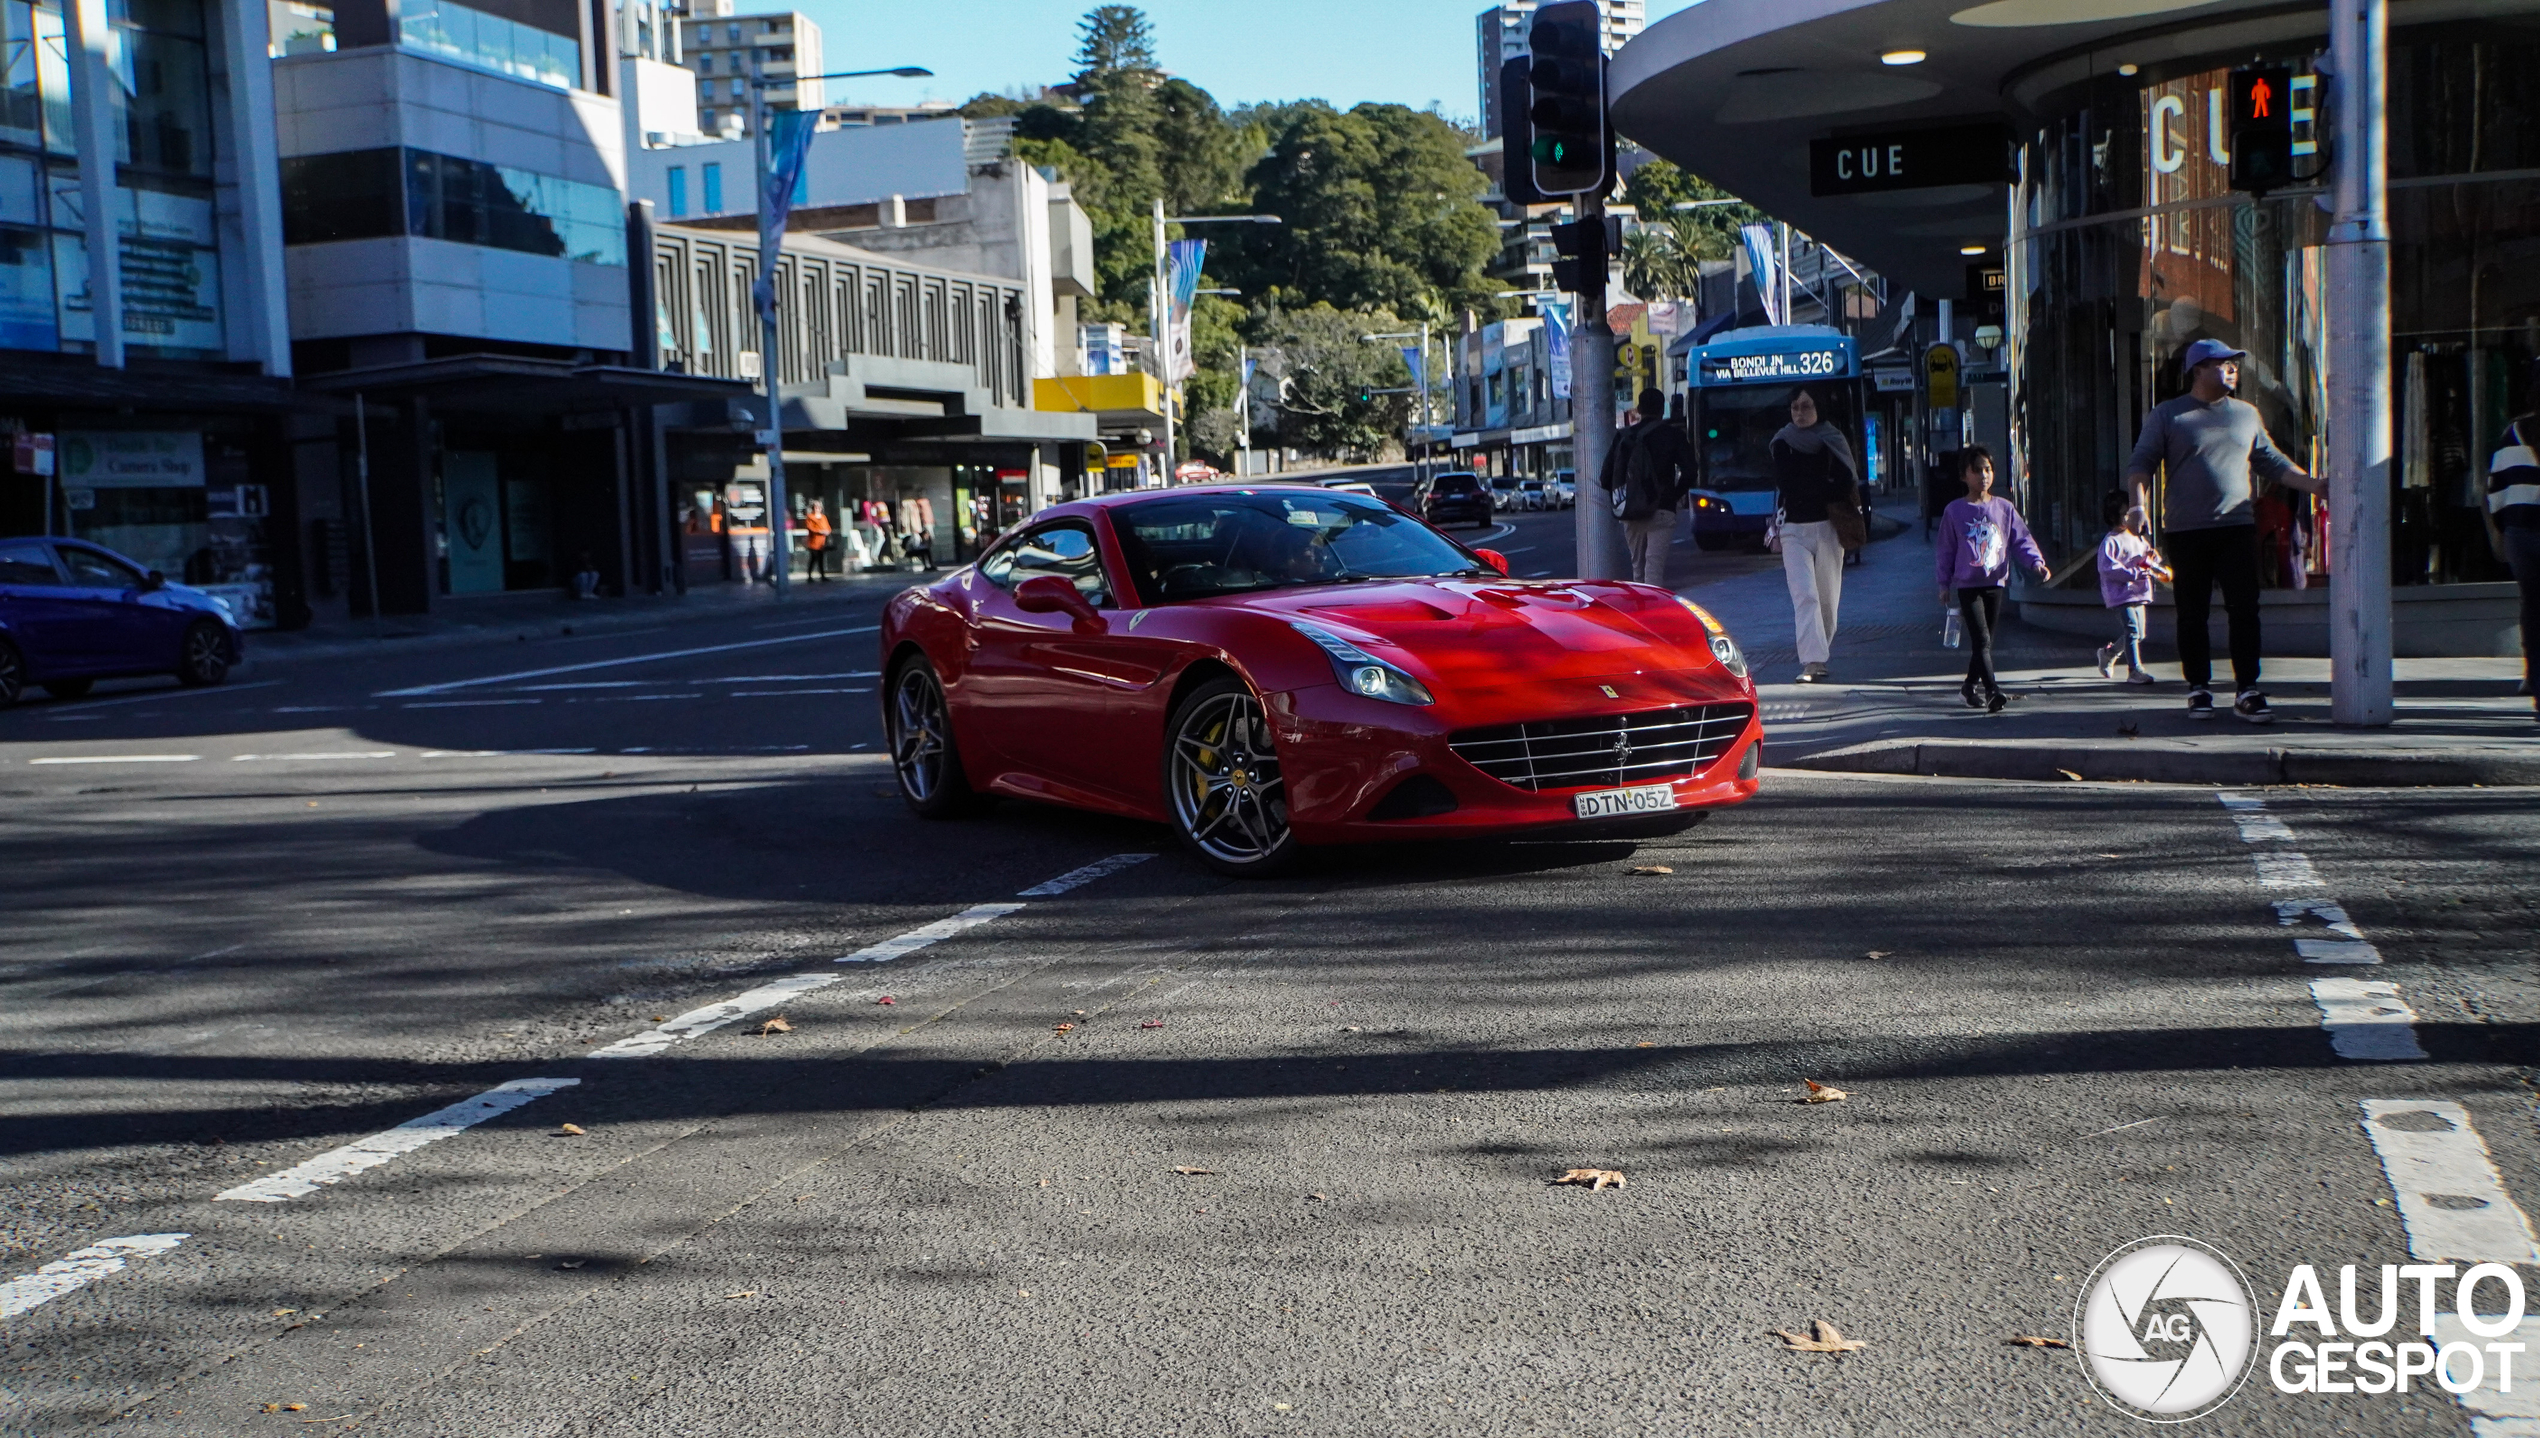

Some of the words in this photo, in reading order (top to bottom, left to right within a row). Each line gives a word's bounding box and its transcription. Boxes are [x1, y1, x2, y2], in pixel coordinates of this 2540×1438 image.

[2152, 74, 2317, 173] CUE
[1837, 145, 1903, 180] CUE
[1716, 369, 1732, 379] VIA
[1733, 366, 1777, 378] BELLEVUE
[1780, 364, 1799, 376] HILL
[1731, 355, 1766, 370] BONDI
[1771, 354, 1784, 367] JN
[1799, 351, 1834, 375] 326
